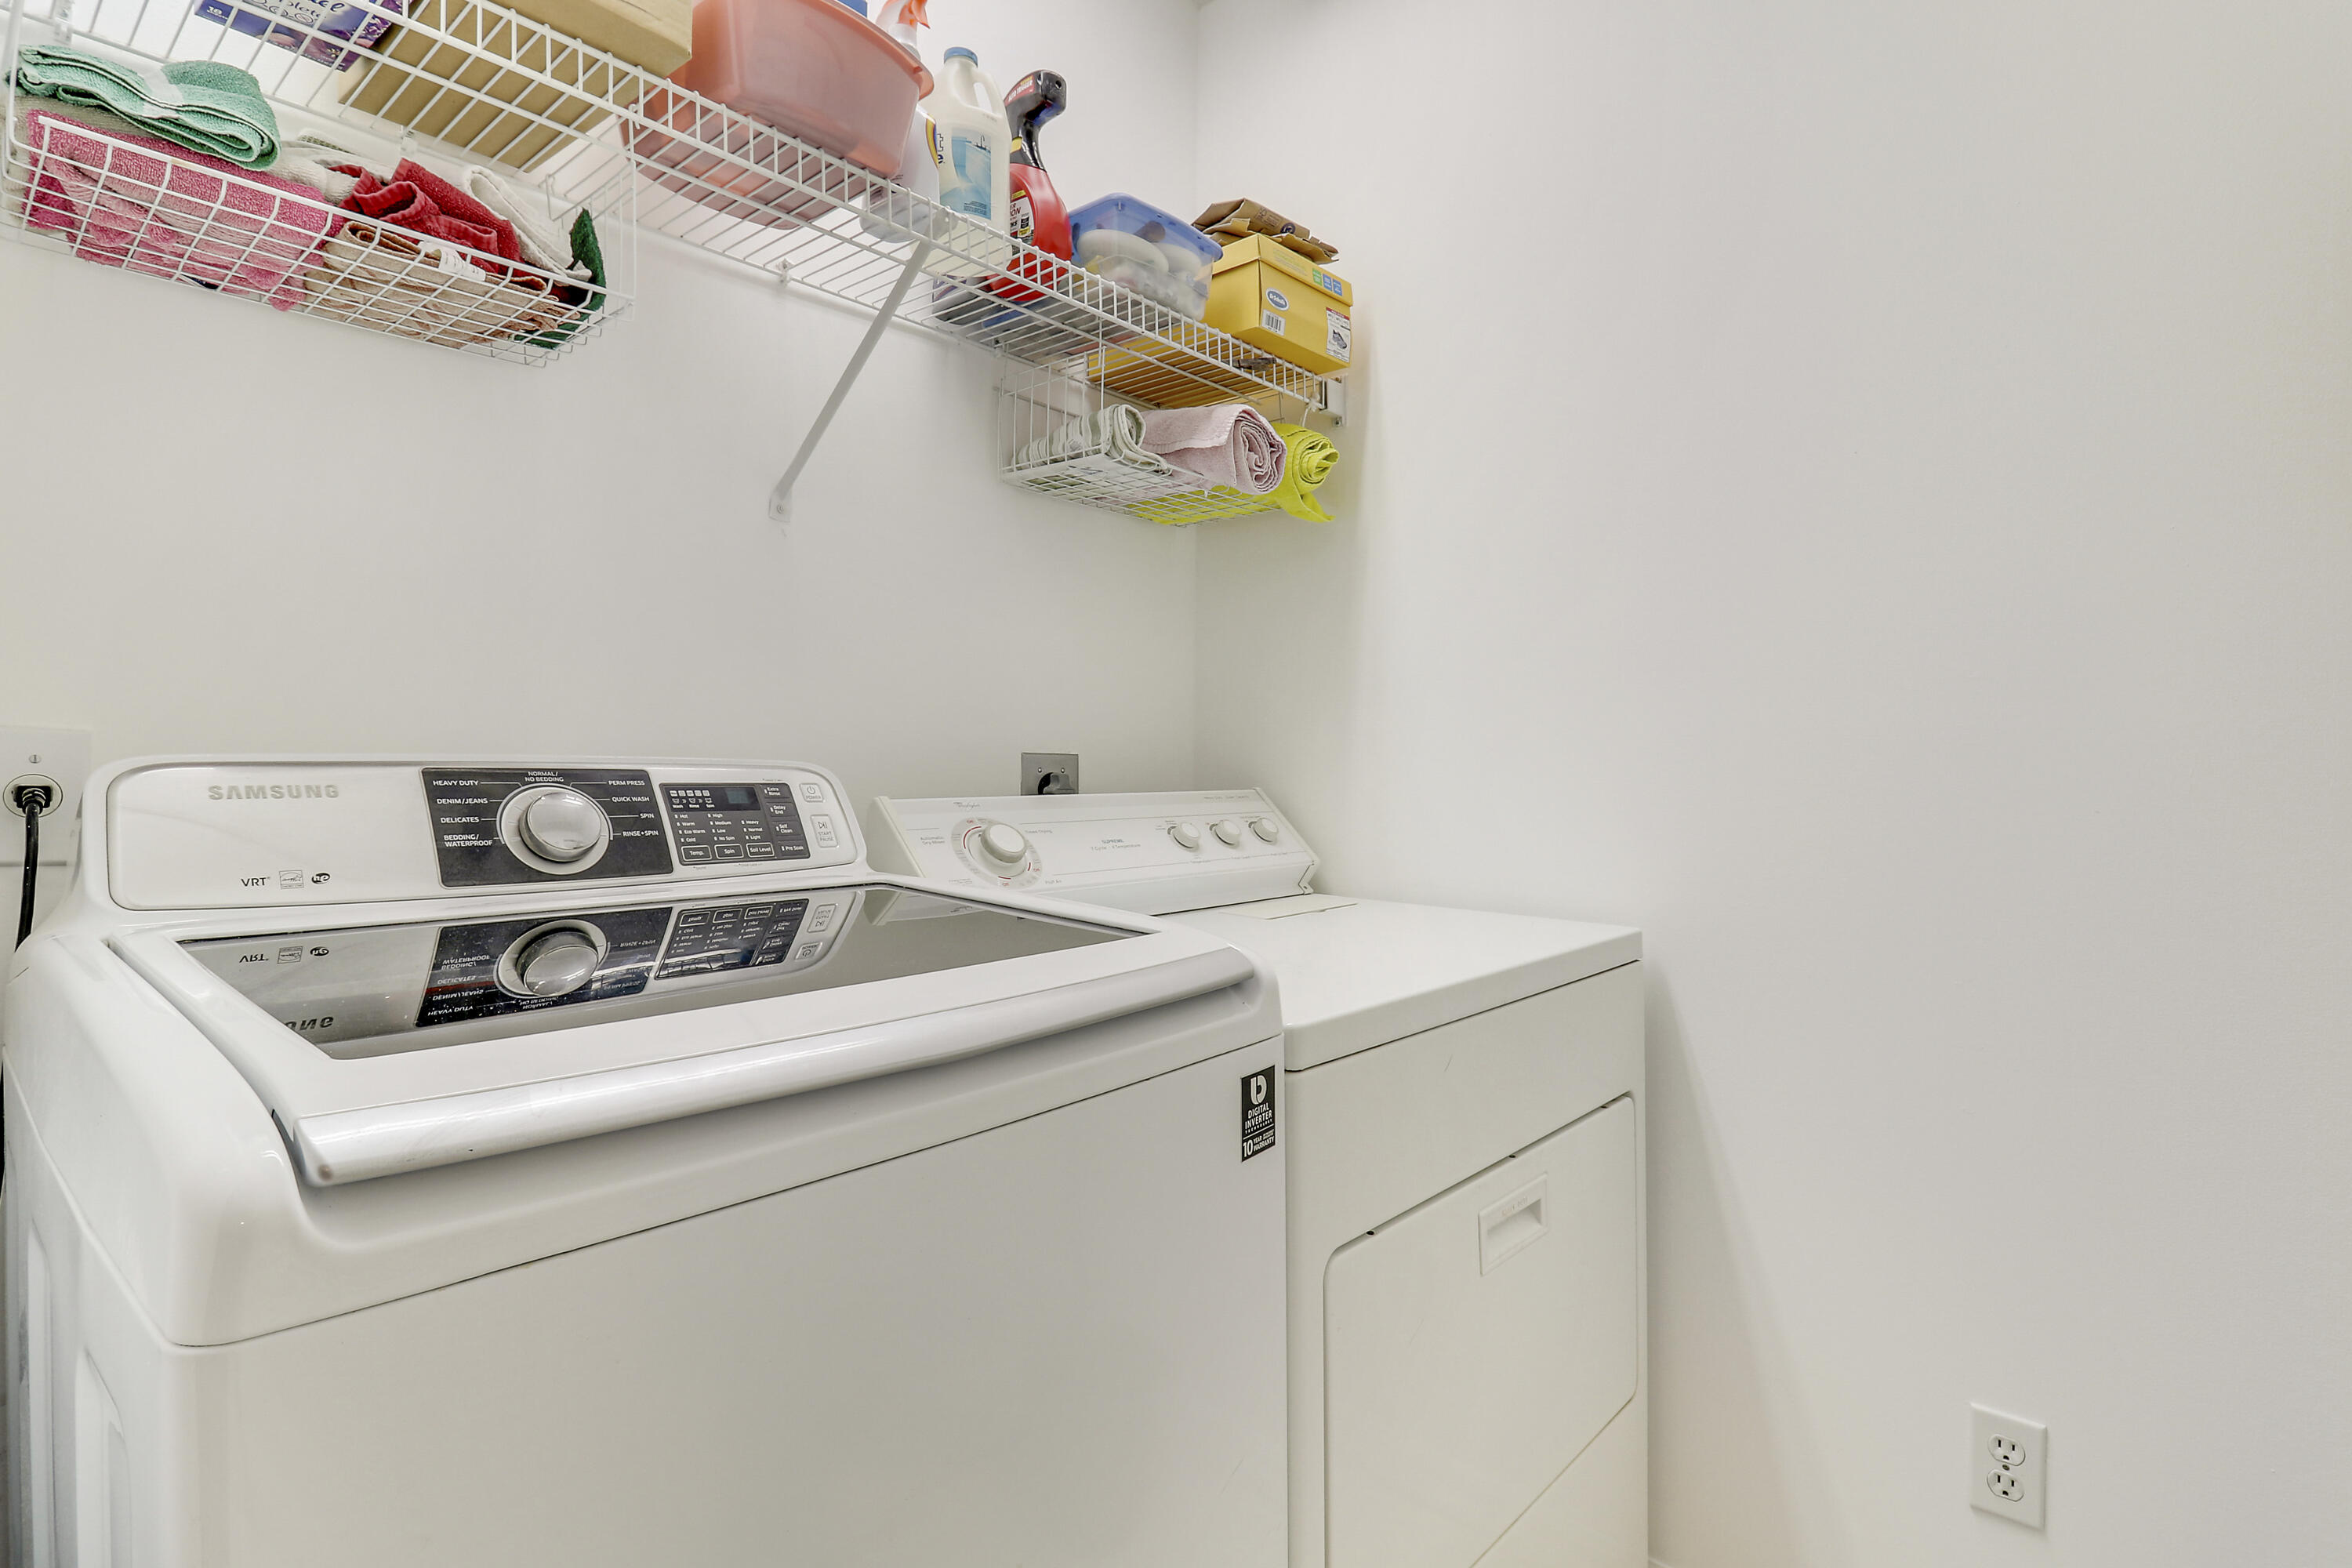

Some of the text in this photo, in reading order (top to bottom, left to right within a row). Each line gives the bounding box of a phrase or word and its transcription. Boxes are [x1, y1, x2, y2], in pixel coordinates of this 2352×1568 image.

[208, 785, 339, 800] SAMSUNG
[1245, 1109, 1272, 1130] INVERTER
[1247, 1102, 1269, 1120] DIGITAL
[1243, 1135, 1262, 1157] 10 YEAR
[1254, 1136, 1275, 1152] WARRANTY
